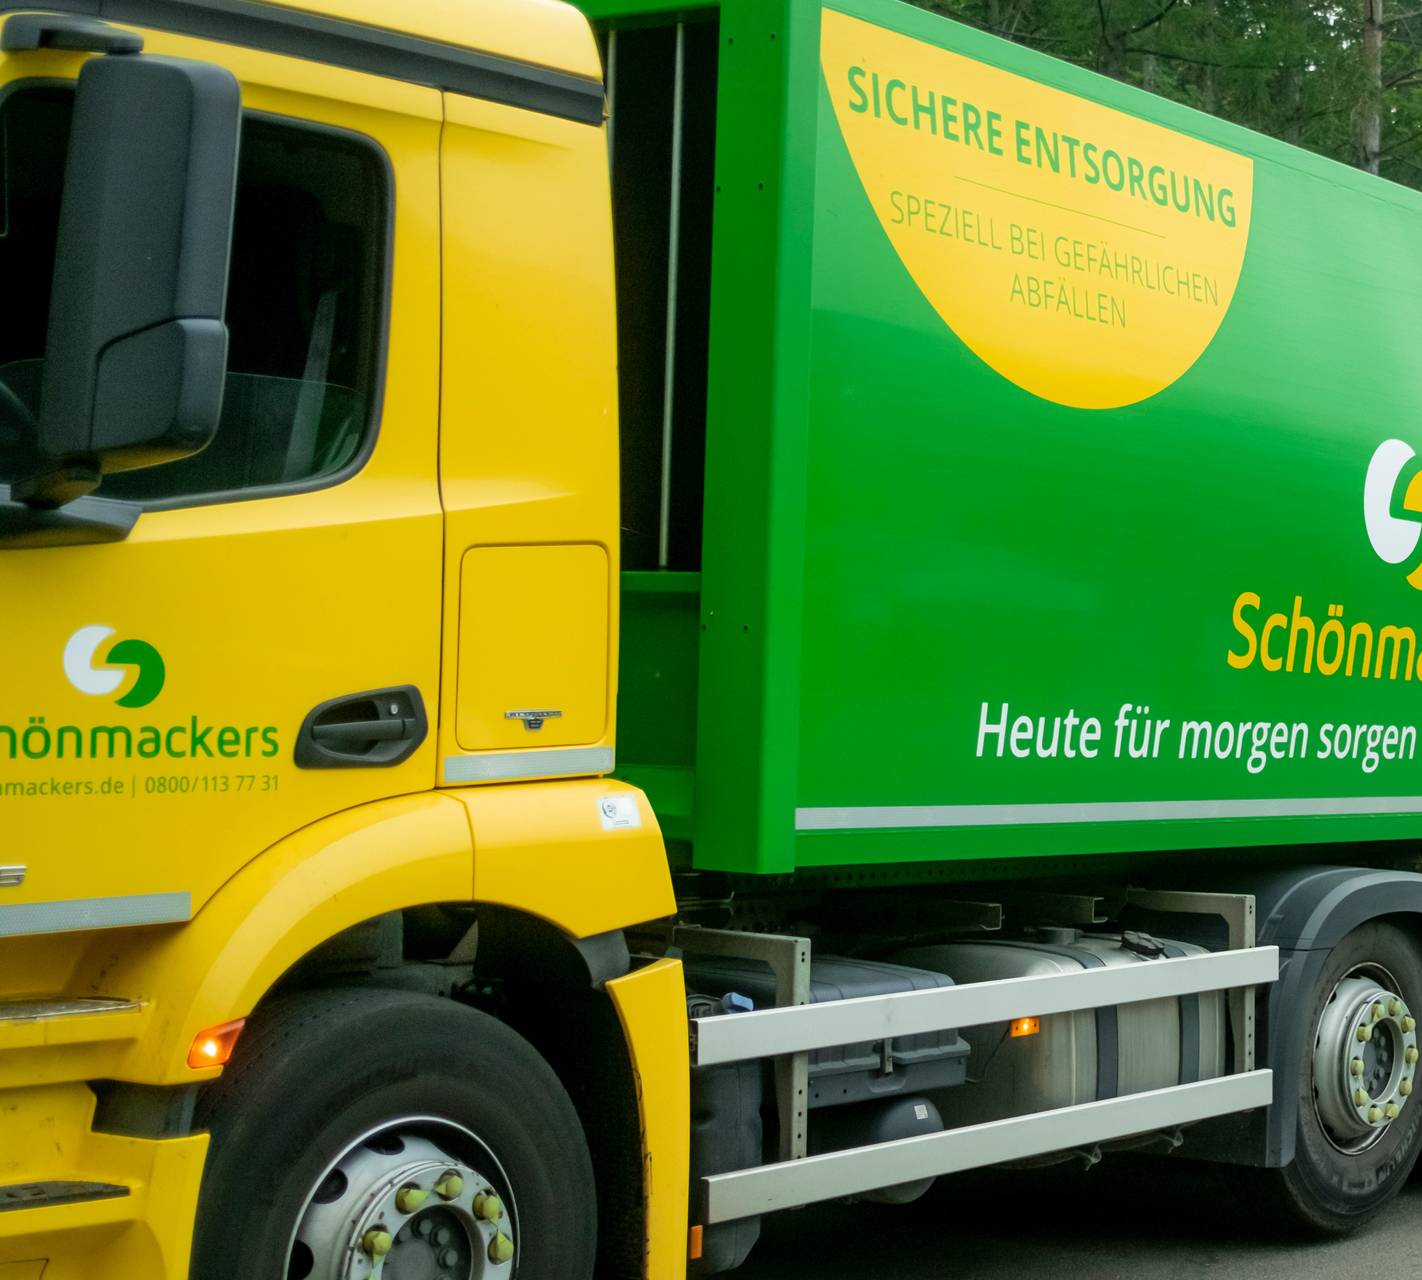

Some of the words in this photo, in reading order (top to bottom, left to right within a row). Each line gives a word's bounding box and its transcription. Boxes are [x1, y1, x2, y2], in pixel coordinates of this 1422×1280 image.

[848, 66, 1003, 155] SICHERE
[1016, 120, 1236, 227] ENTSORGUNG
[889, 190, 1002, 251] SPEZIELL
[1009, 223, 1046, 262] BEI
[1054, 236, 1218, 306] GEFÄHRLICHEN
[1010, 272, 1127, 328] ABFÄLLEN
[976, 702, 1102, 758] Heute
[1113, 704, 1170, 759] für
[1178, 720, 1309, 774] morgen
[1317, 721, 1416, 773] sorgen
[144, 775, 229, 794] 0800/113
[236, 775, 256, 791] 77
[261, 775, 279, 791] 31
